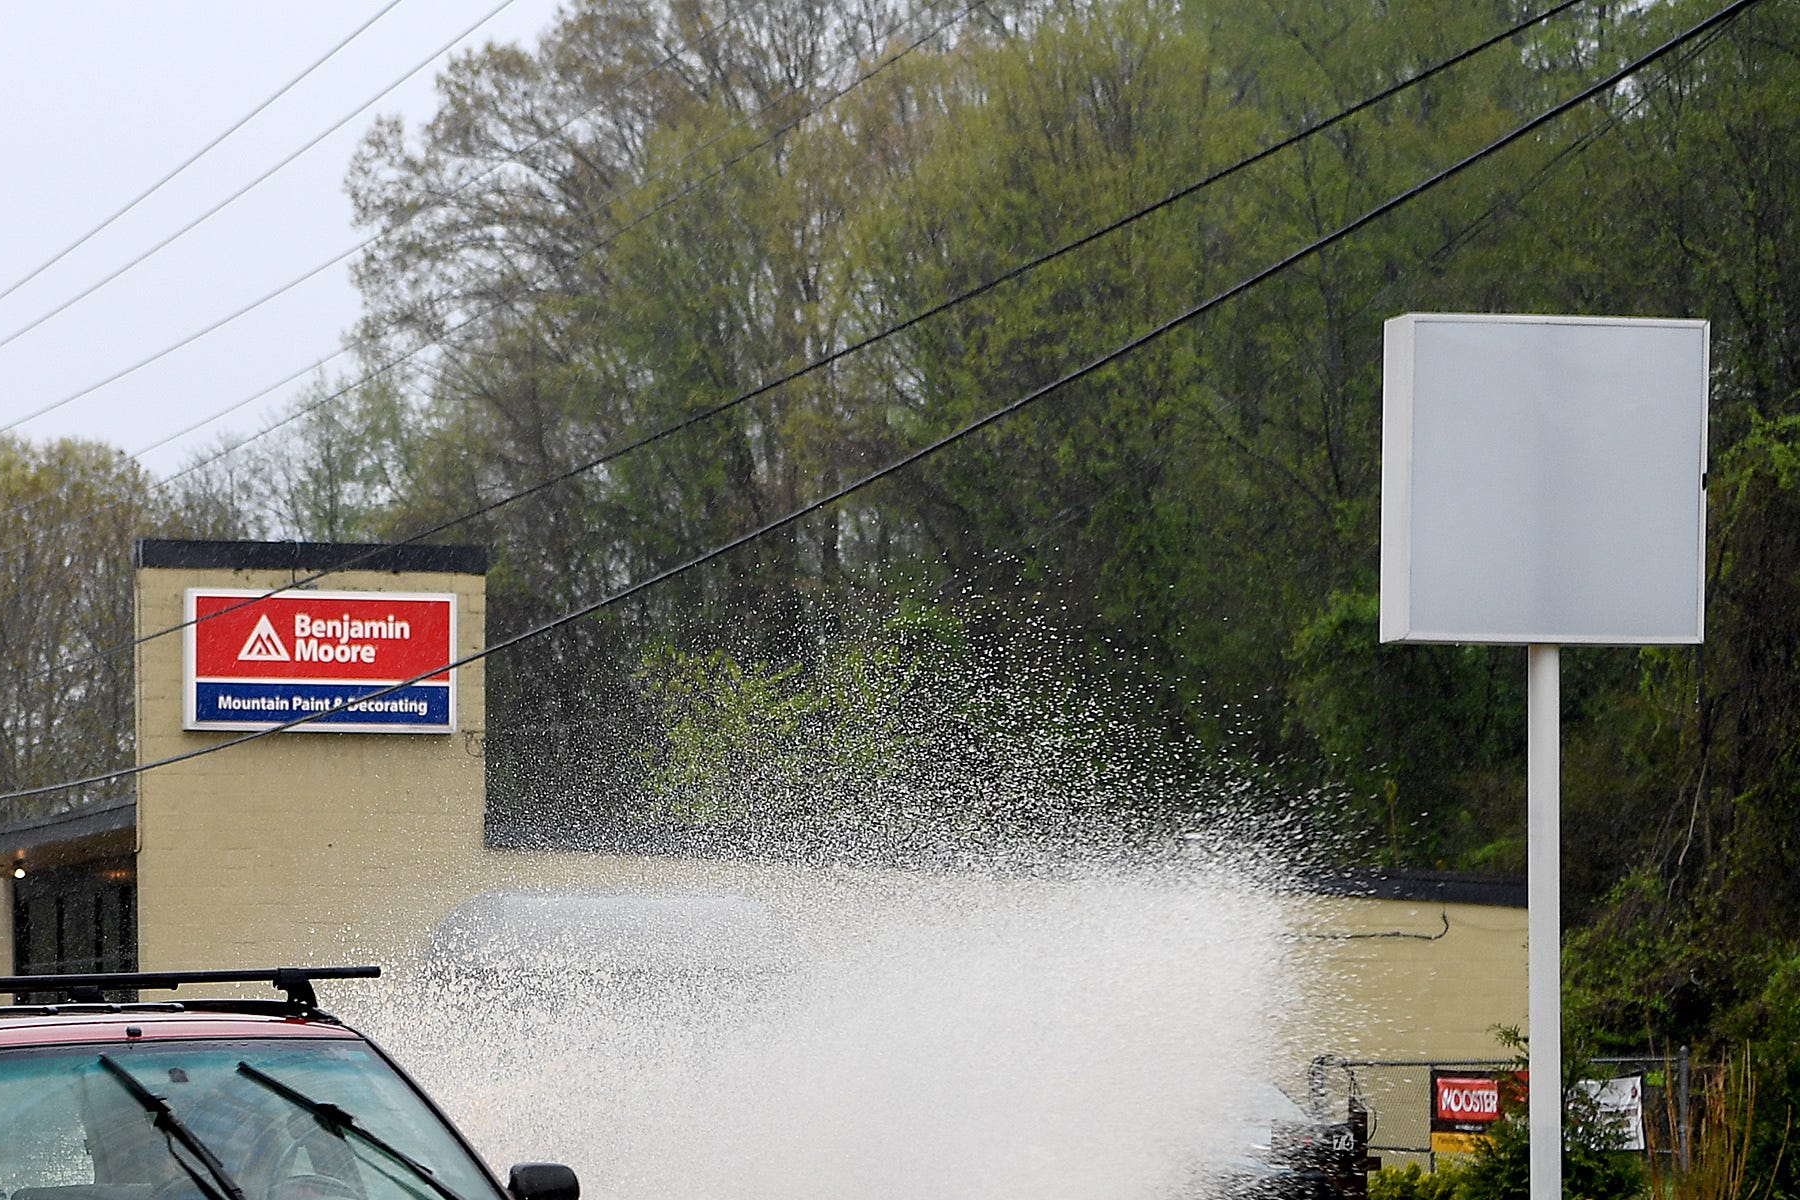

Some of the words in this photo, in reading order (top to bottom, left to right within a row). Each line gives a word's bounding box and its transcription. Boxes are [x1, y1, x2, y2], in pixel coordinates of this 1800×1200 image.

[295, 614, 410, 644] Benjamin
[295, 639, 376, 662] Moore
[218, 695, 290, 711] Mountain
[292, 696, 330, 711] Paint
[347, 697, 428, 716] Decorating
